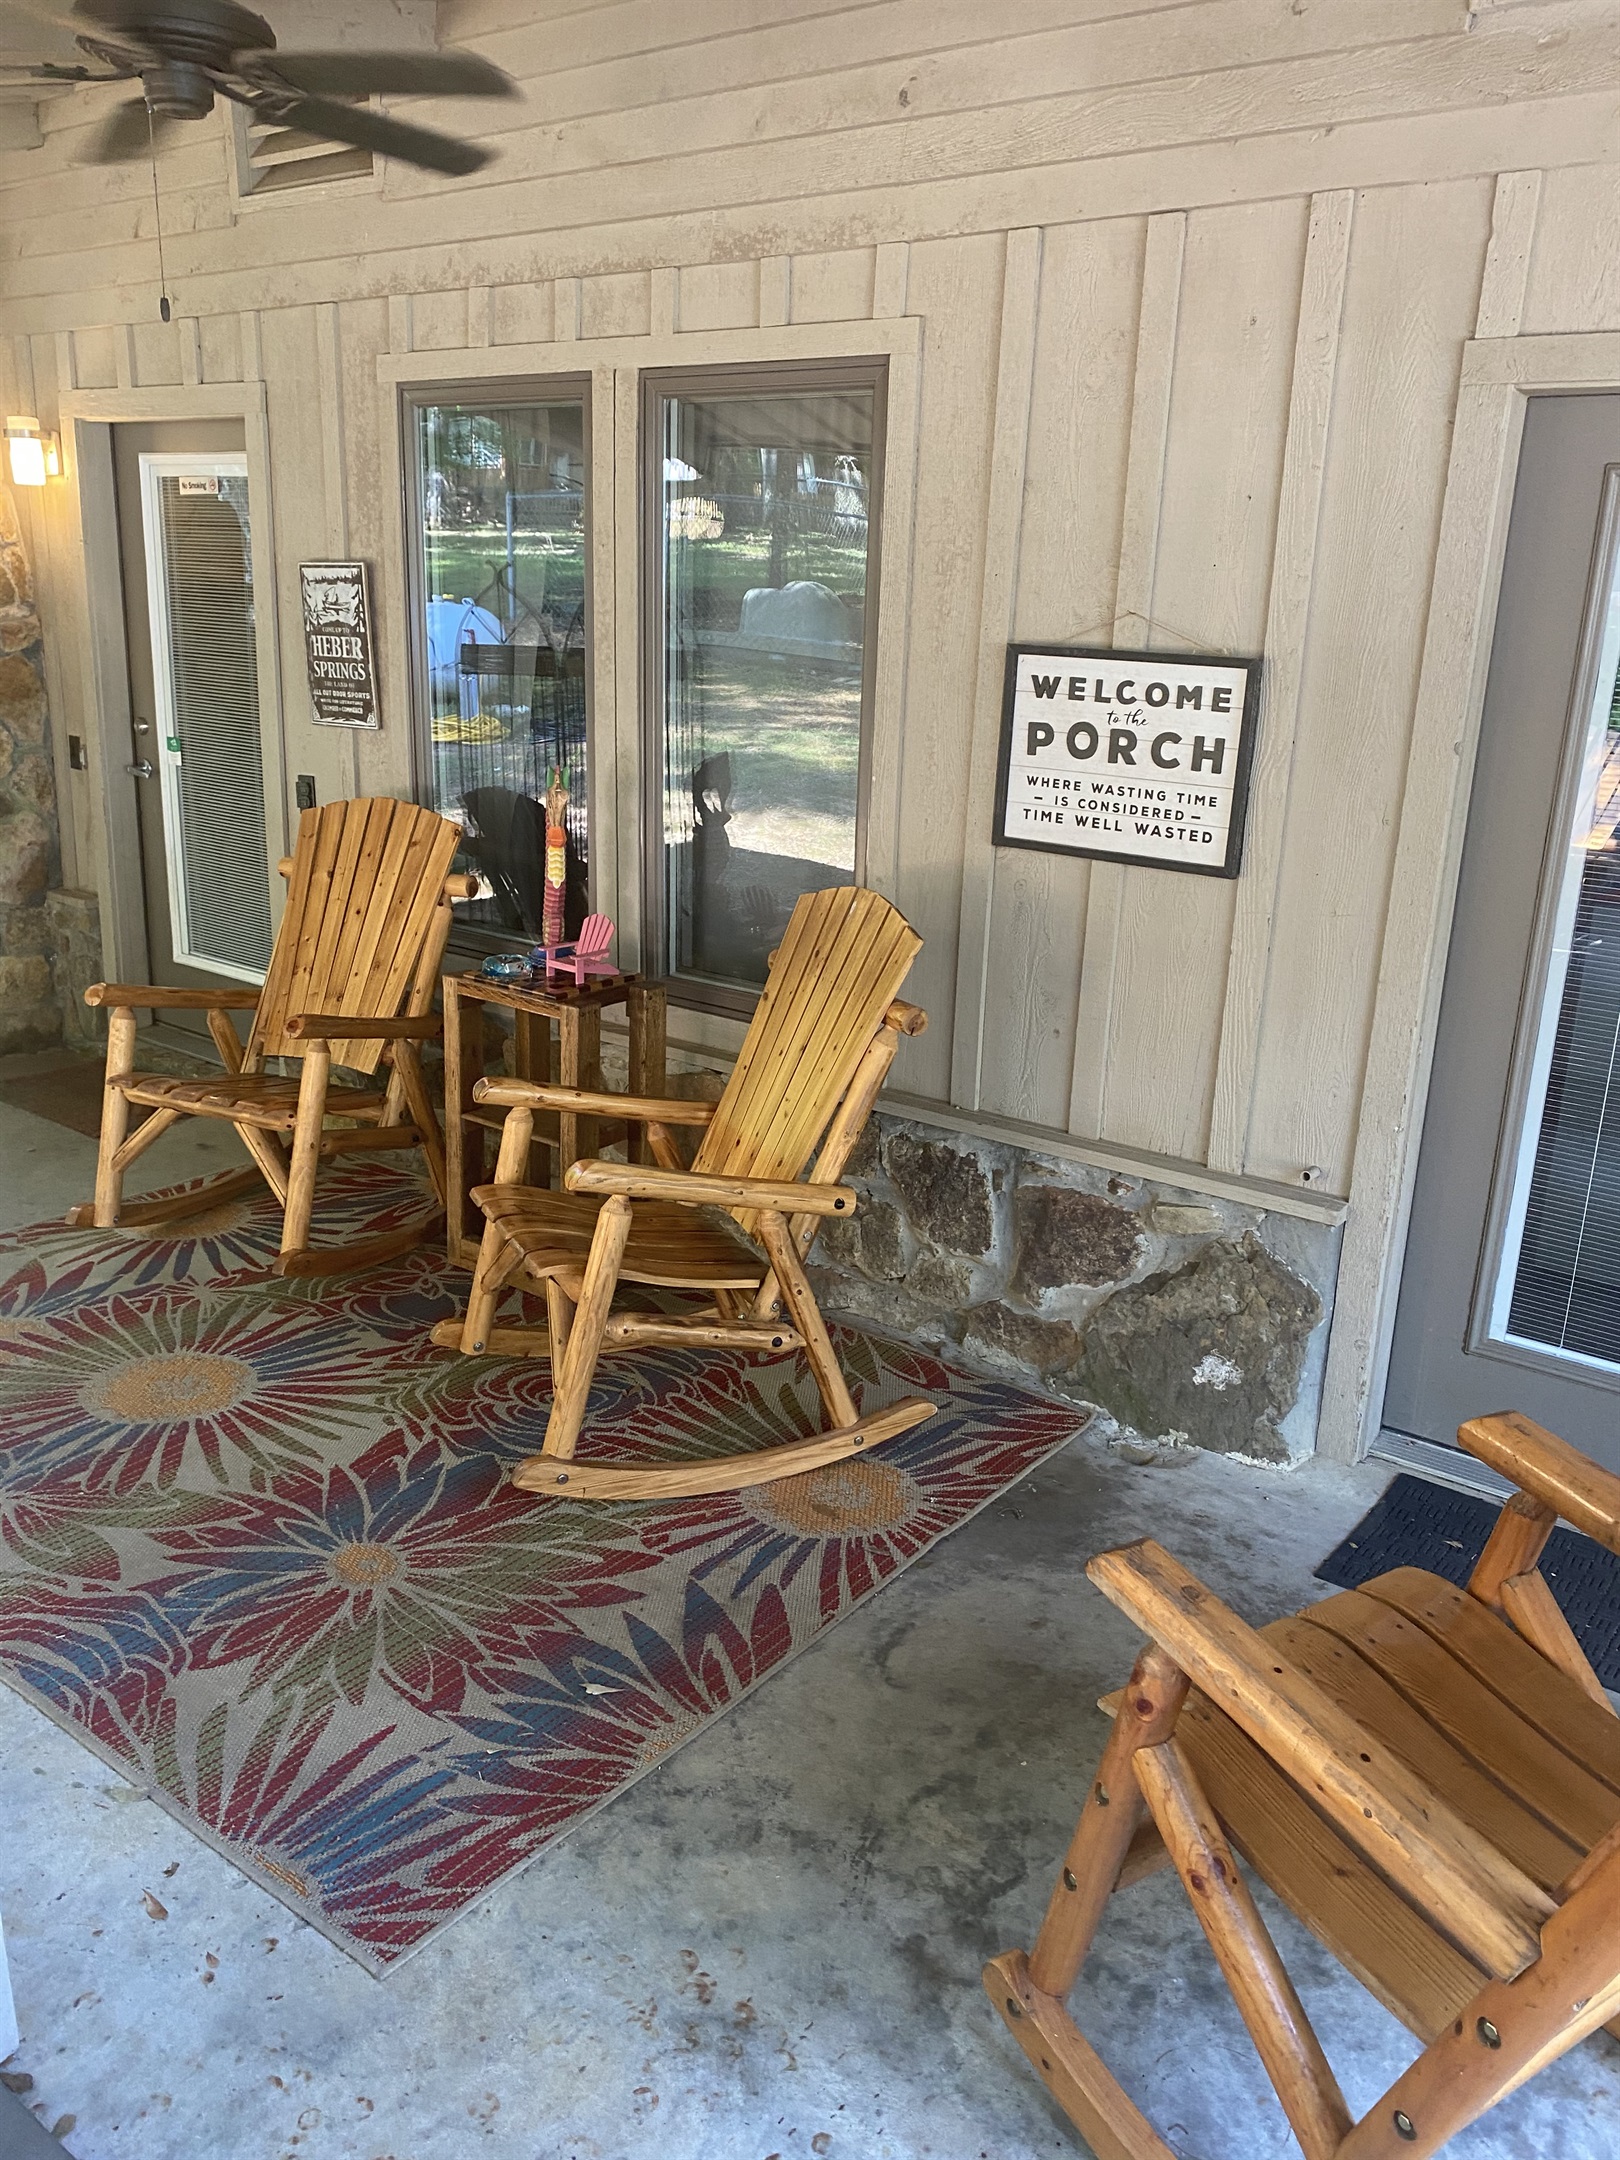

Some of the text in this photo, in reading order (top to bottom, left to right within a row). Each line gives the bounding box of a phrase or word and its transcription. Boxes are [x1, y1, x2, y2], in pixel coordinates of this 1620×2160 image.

[311, 634, 364, 660] HEBER
[314, 660, 366, 680] SPRINGS
[347, 692, 370, 700] SPORTS
[1031, 674, 1232, 713] WELCOME
[1106, 708, 1149, 726] to the
[1026, 721, 1226, 775] PORCH
[1026, 775, 1218, 808] WHERE WASTING TIME
[1054, 795, 1185, 821] IS CONSIDERED
[1023, 808, 1213, 844] TIME WELL WASTED
